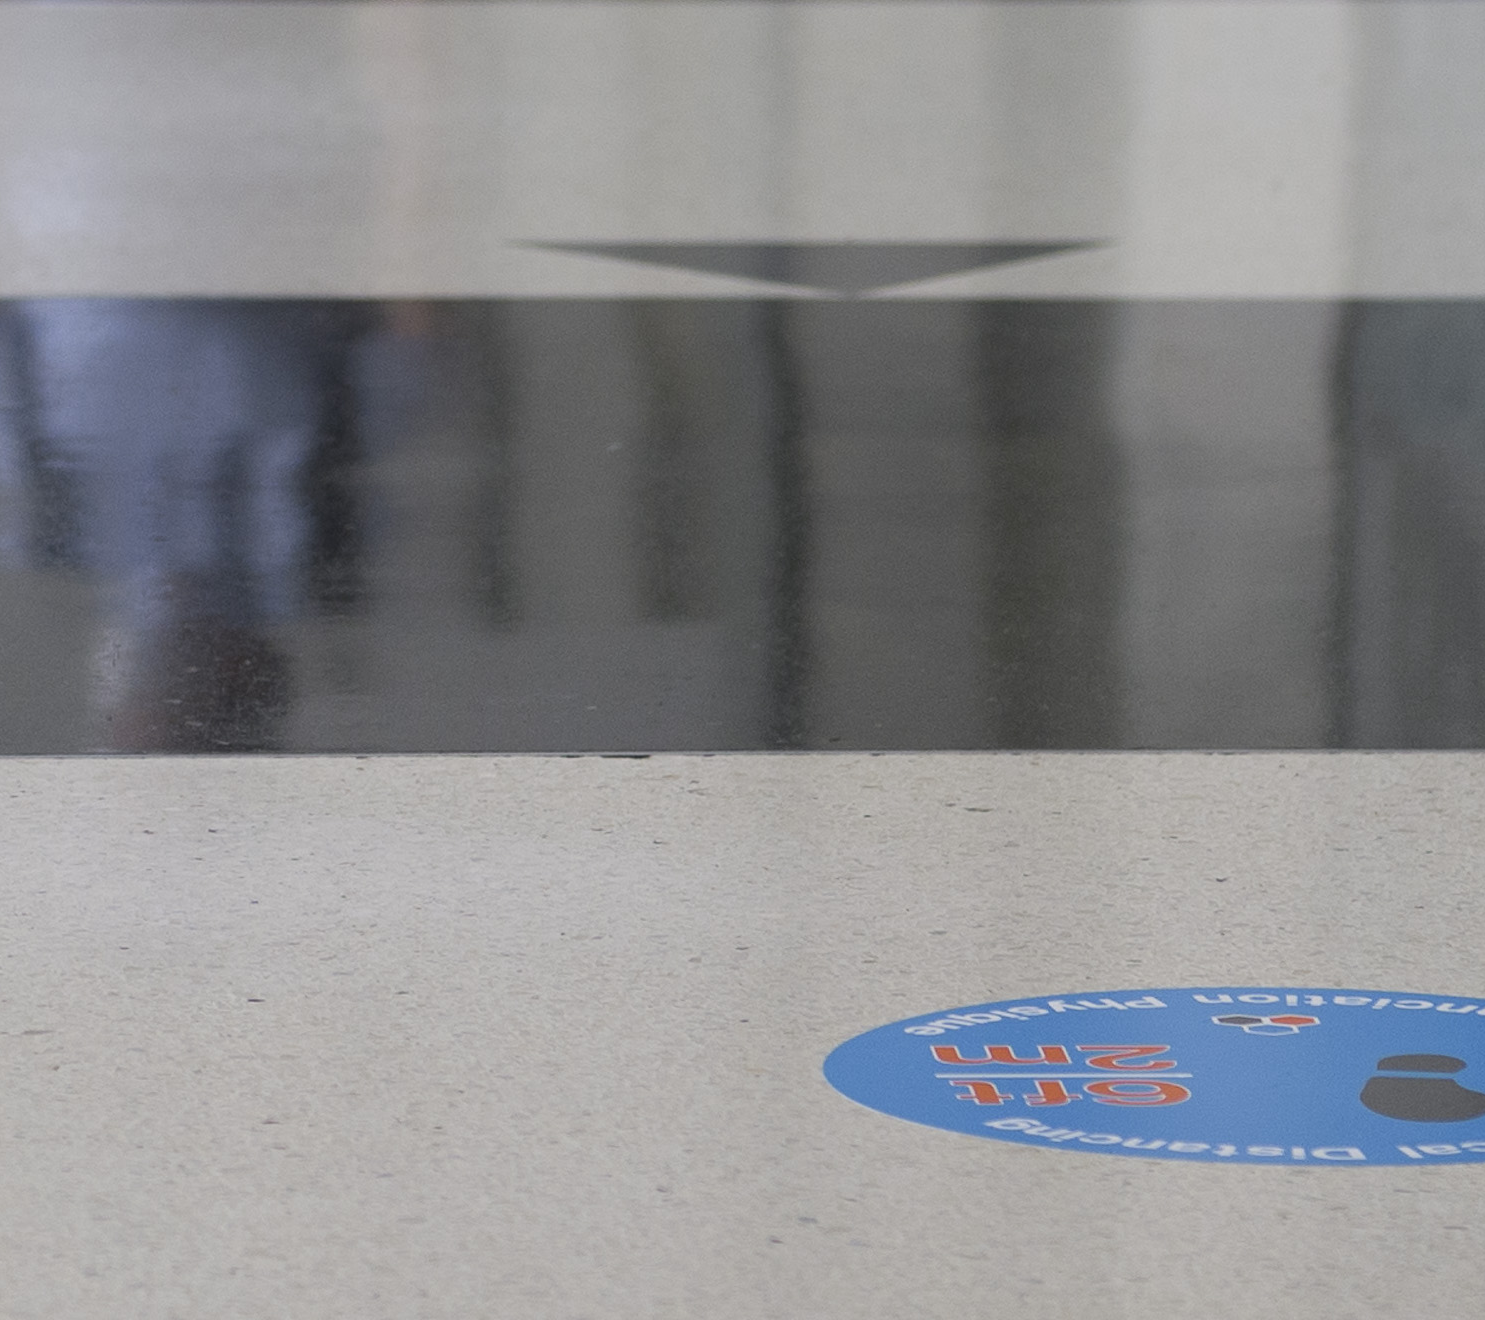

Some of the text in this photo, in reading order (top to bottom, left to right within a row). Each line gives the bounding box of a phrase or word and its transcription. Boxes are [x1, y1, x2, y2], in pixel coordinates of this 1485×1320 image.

[903, 994, 1164, 1038] Physique
[929, 1044, 1178, 1070] 2m
[948, 1079, 1192, 1107] 6ft
[983, 1117, 1367, 1161] Distancing
